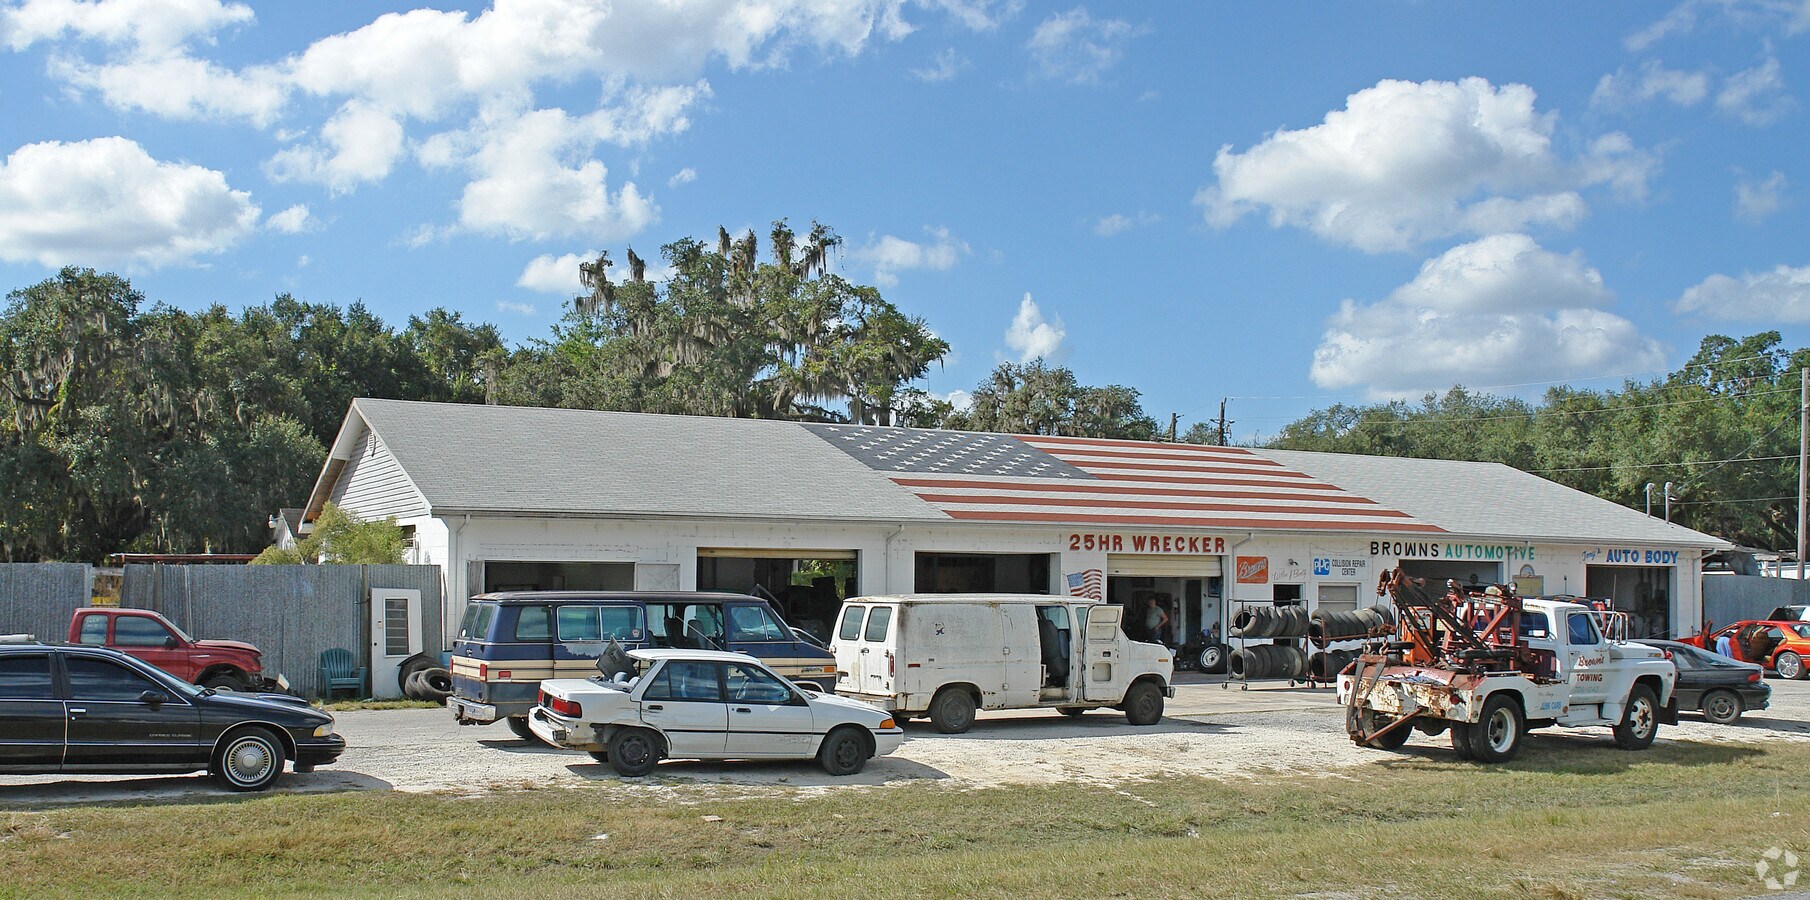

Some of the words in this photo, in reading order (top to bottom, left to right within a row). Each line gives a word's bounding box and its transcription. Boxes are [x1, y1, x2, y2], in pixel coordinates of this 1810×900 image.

[1069, 533, 1123, 551] 25HR
[1132, 535, 1225, 553] WRECKER
[1370, 541, 1439, 557] BROWNS
[1445, 544, 1535, 560] AUTOMOTIVE
[1606, 549, 1640, 563] AUTO
[1645, 550, 1679, 564] BODY
[1314, 560, 1330, 573] PPG
[1331, 559, 1352, 568] COLLISION
[1352, 559, 1366, 568] REPAIR
[1341, 567, 1356, 576] CENTER
[1576, 673, 1603, 682] TOWING
